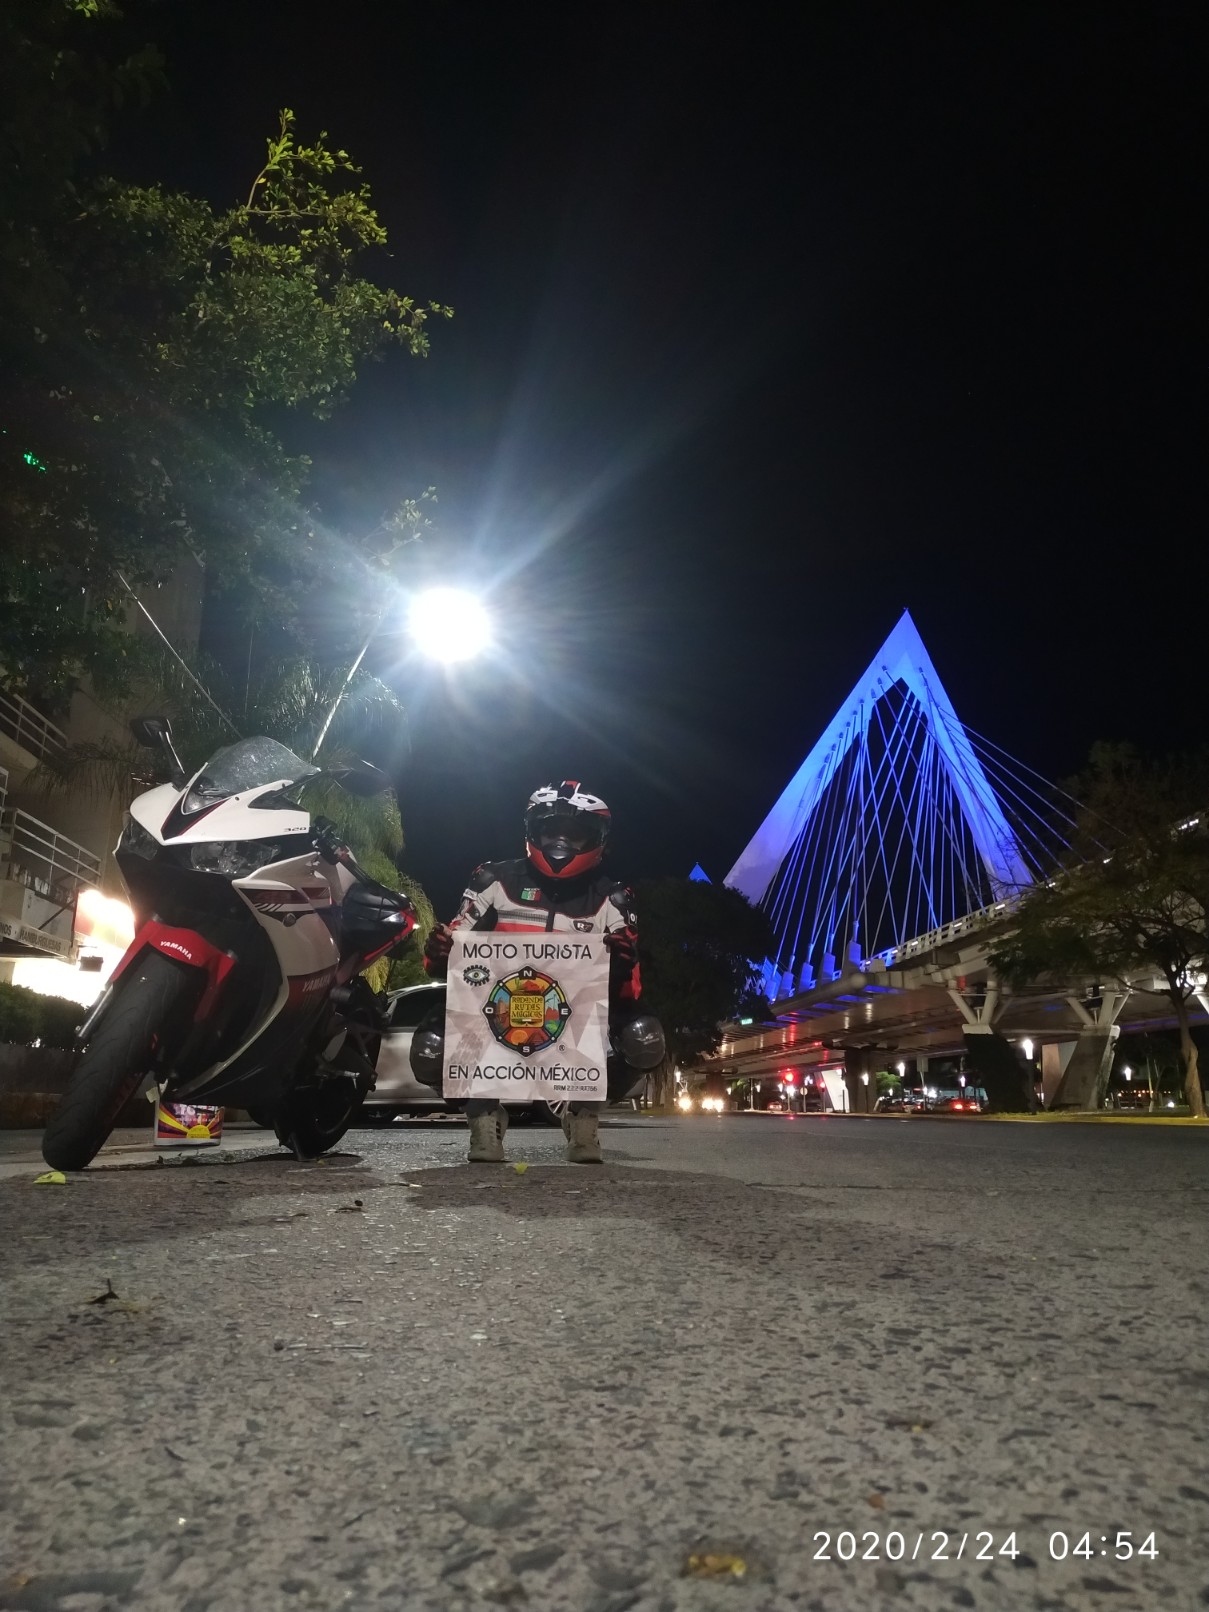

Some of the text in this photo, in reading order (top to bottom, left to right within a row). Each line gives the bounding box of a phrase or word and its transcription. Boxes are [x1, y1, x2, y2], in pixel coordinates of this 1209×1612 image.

[160, 941, 192, 960] YAMAHA
[463, 943, 592, 960] MOTO TURISTA
[302, 974, 331, 992] YAMAHA
[448, 1062, 600, 1082] EN ACCIÓN MÉXICO
